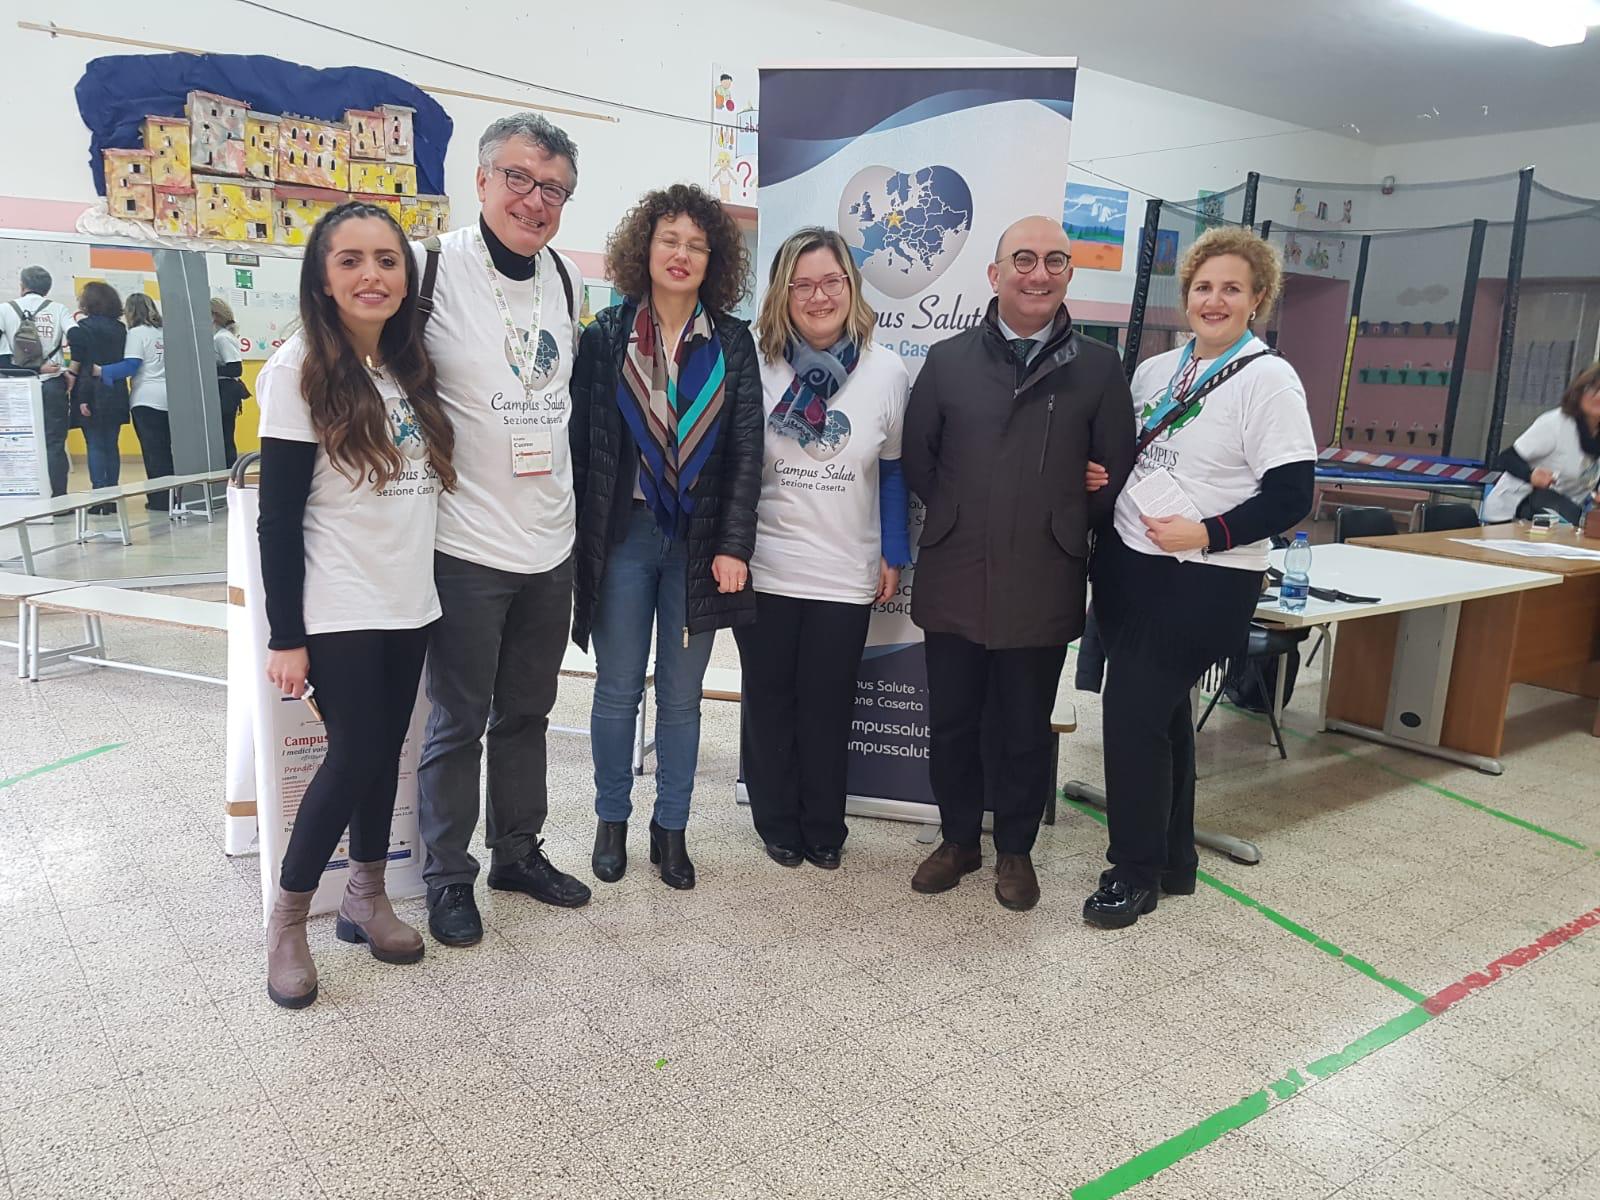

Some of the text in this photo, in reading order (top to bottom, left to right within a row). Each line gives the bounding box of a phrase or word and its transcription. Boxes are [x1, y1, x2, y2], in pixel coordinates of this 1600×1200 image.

[491, 392, 541, 415] Campus
[503, 415, 539, 425] Sezione
[774, 458, 856, 482] Campus Salute
[780, 478, 846, 492] Sezione Caserta
[877, 680, 916, 694] Salute
[877, 696, 924, 711] Caserta
